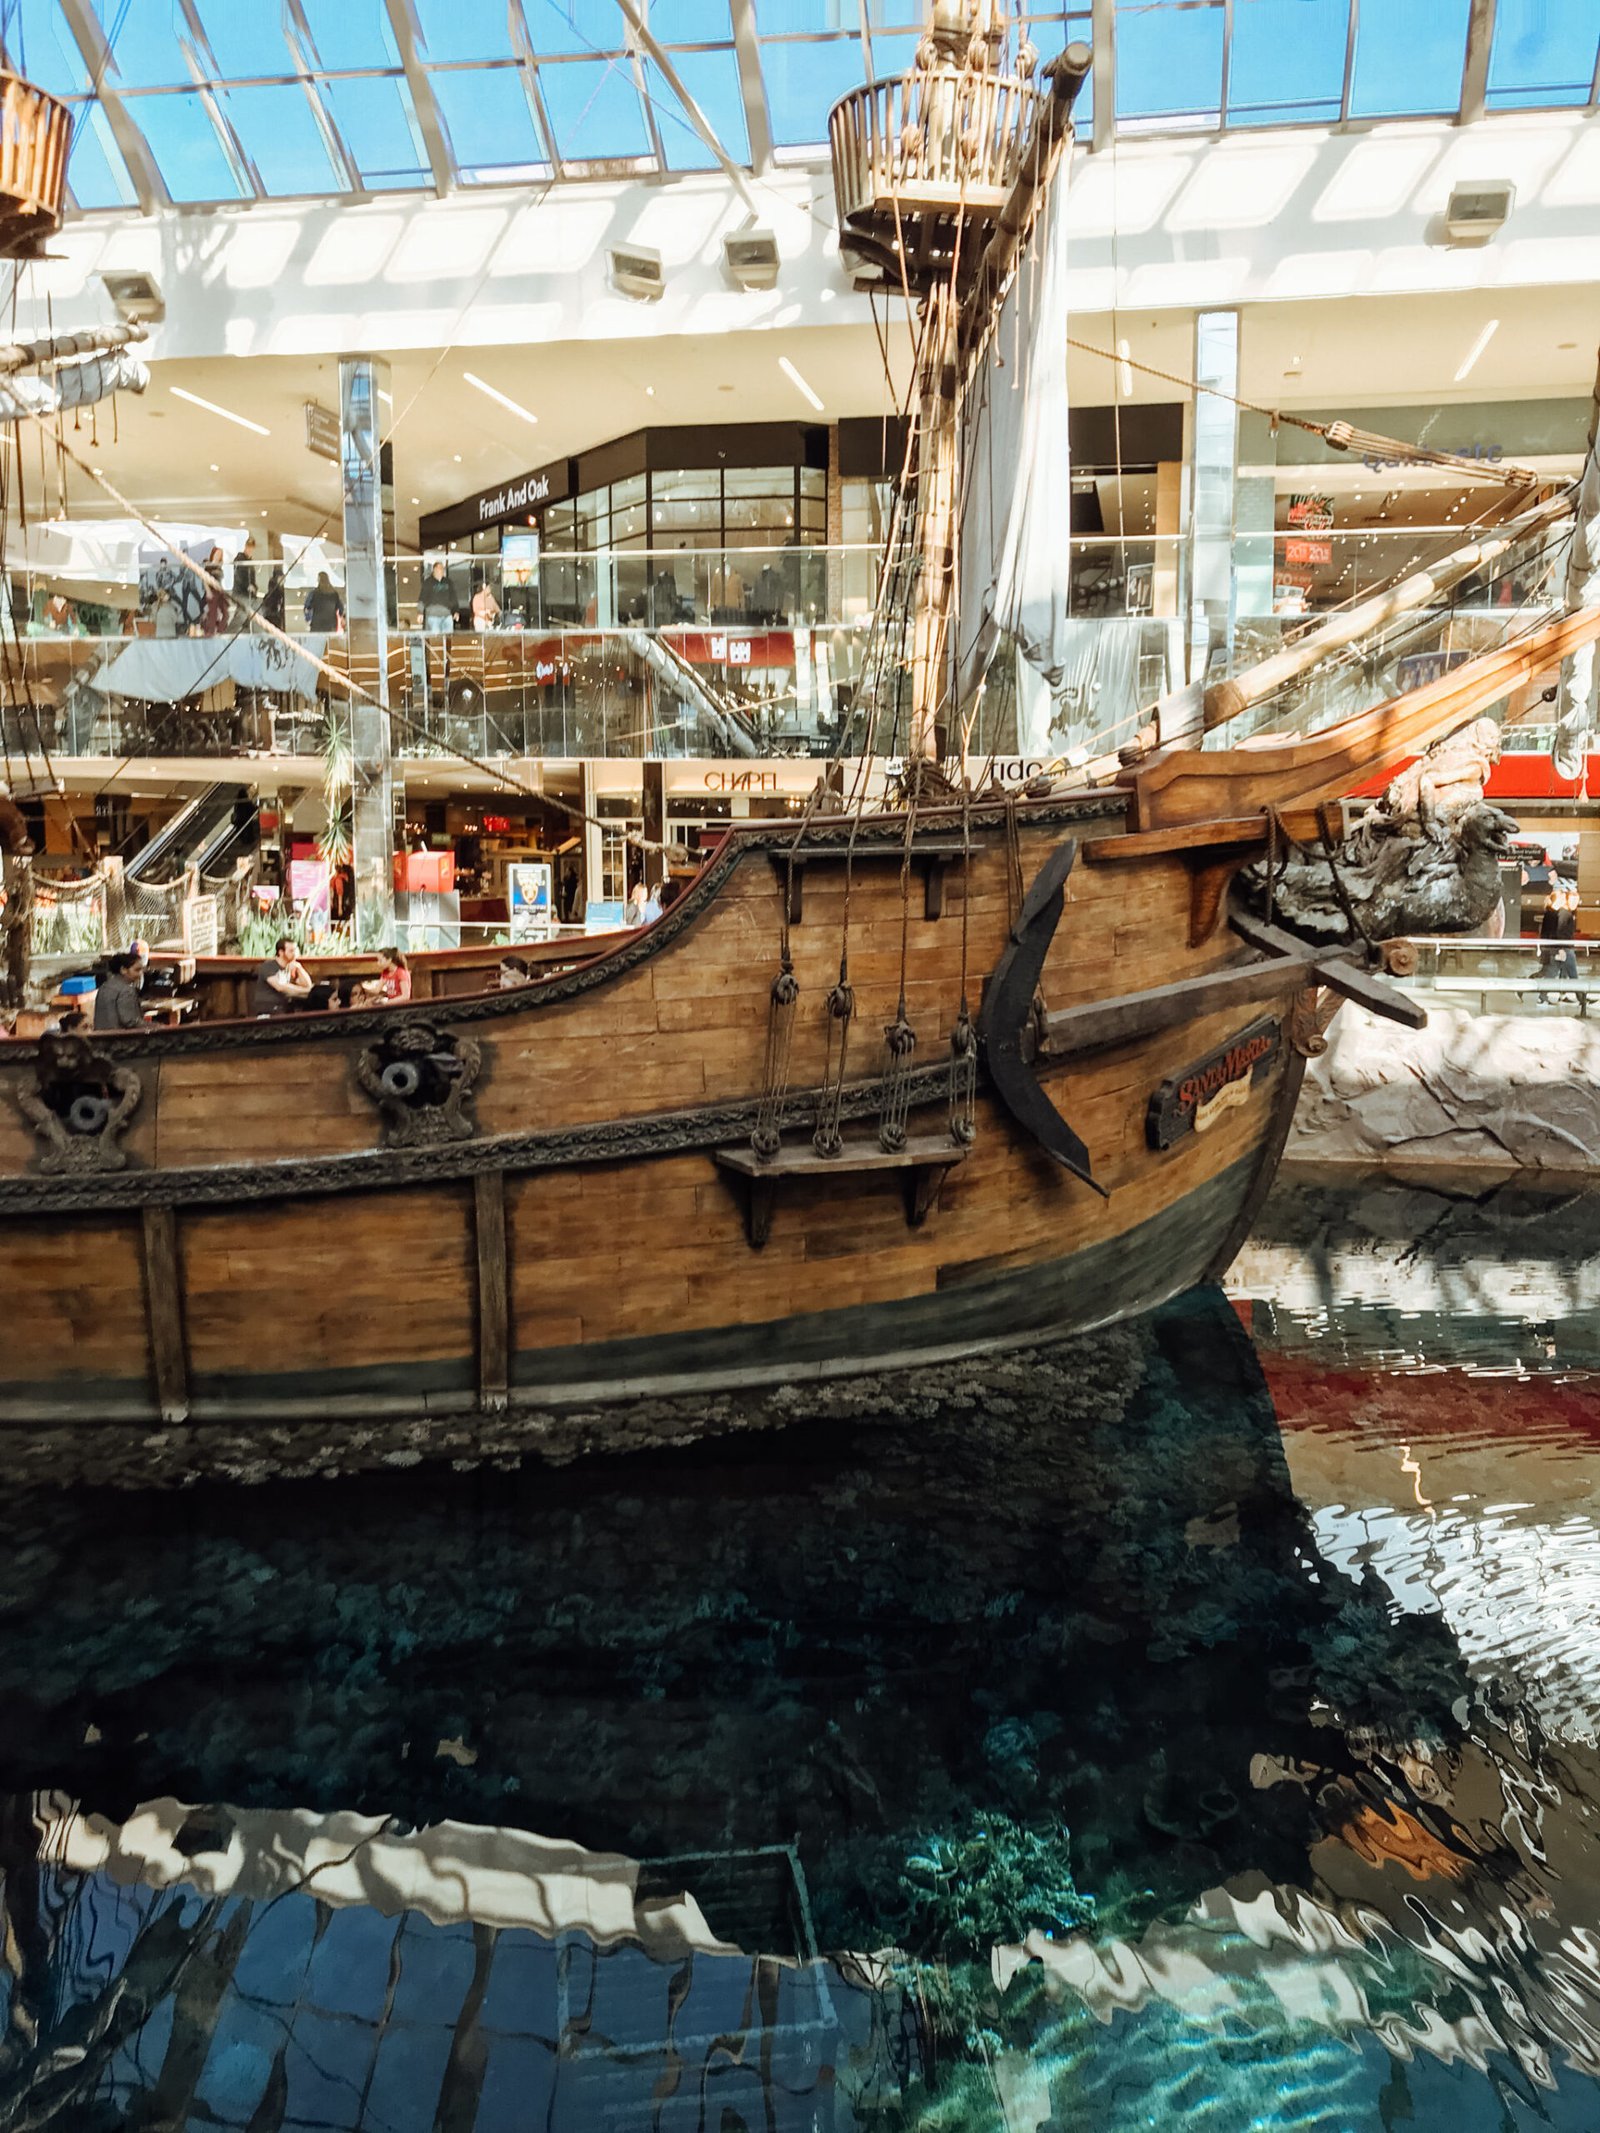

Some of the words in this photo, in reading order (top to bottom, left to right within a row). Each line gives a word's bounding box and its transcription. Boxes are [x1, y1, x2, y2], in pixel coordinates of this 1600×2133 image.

[480, 491, 506, 520] Frank
[506, 481, 527, 511] And
[527, 474, 549, 502] Oak
[704, 771, 784, 791] CHAPEL
